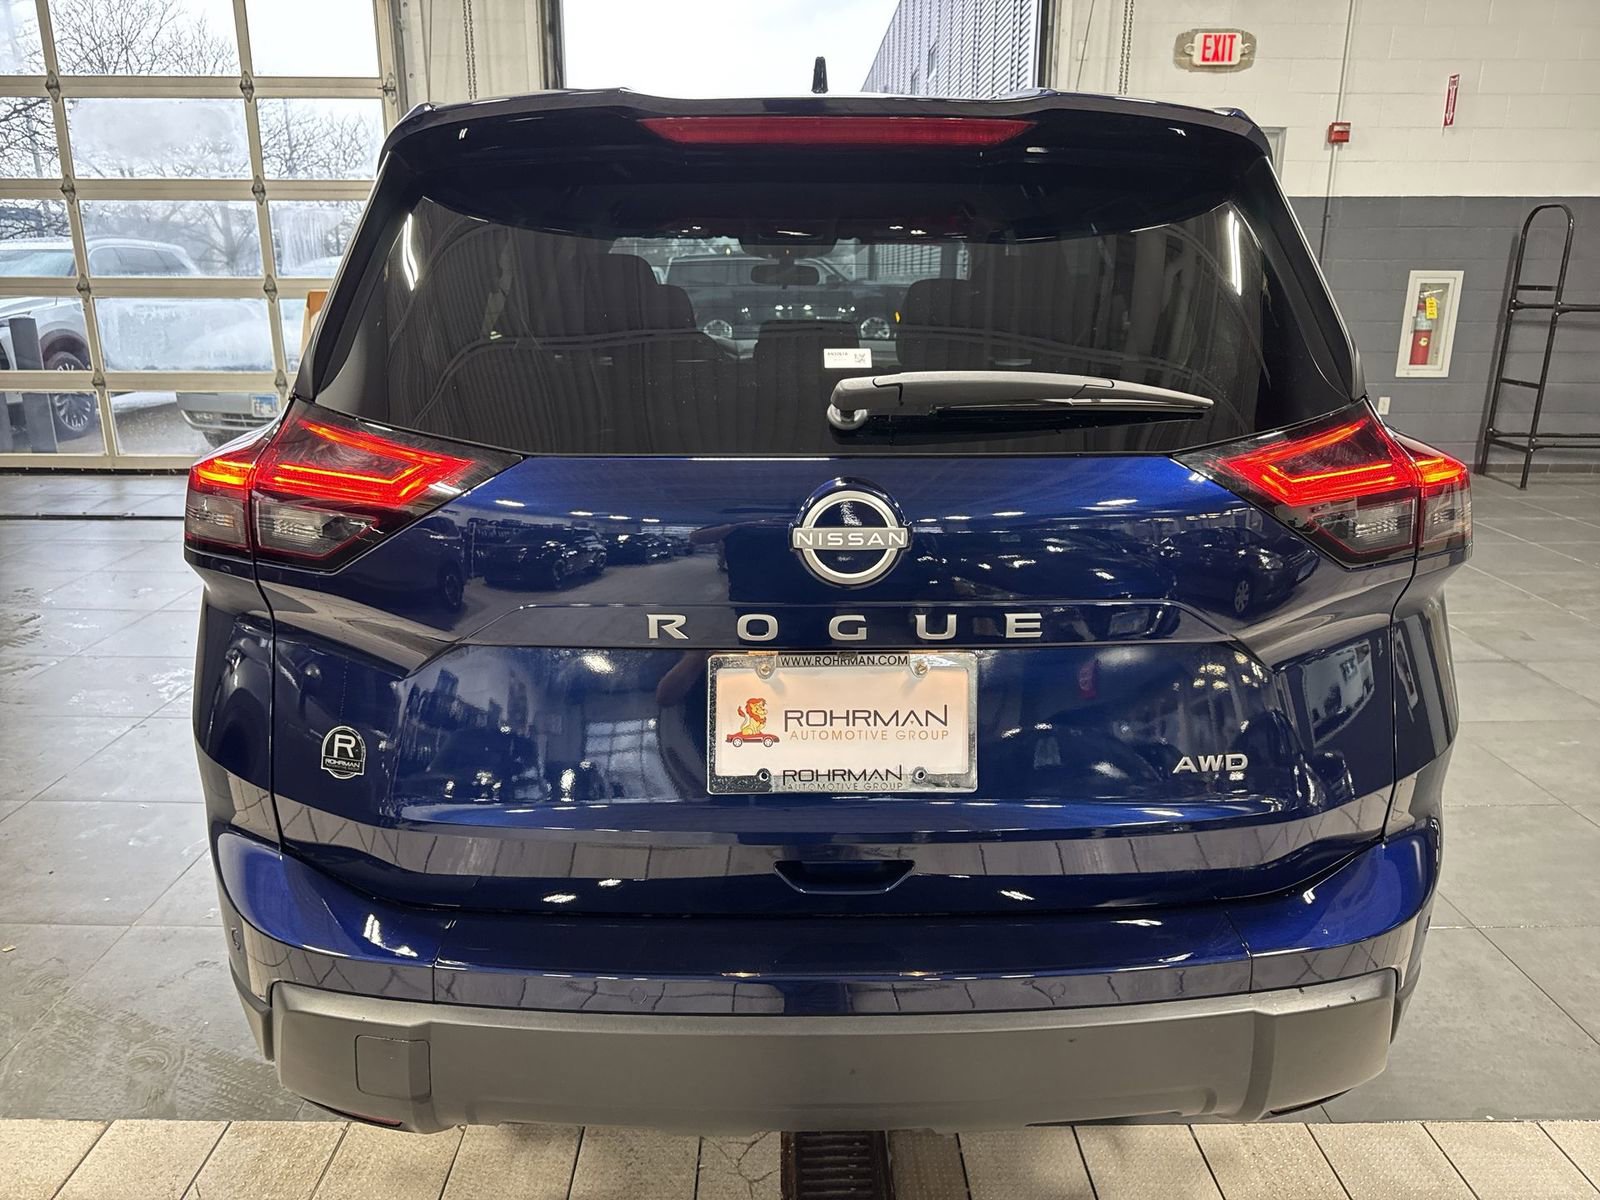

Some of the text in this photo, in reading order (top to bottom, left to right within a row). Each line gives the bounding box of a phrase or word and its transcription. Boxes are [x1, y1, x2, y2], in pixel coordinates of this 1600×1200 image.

[1201, 34, 1237, 62] EXIT
[796, 532, 905, 546] NISSAN
[646, 613, 1043, 641] ROGUE
[780, 655, 908, 666] WWW.ROHRMAN.COM
[784, 704, 948, 732] ROHRMAN
[790, 730, 949, 740] AUTOMOTIVE GROUP
[333, 734, 356, 758] R
[1172, 753, 1248, 773] AWD
[783, 765, 902, 785] ROHRMAN
[787, 782, 903, 791] AUTOMOTIVE GROUP
